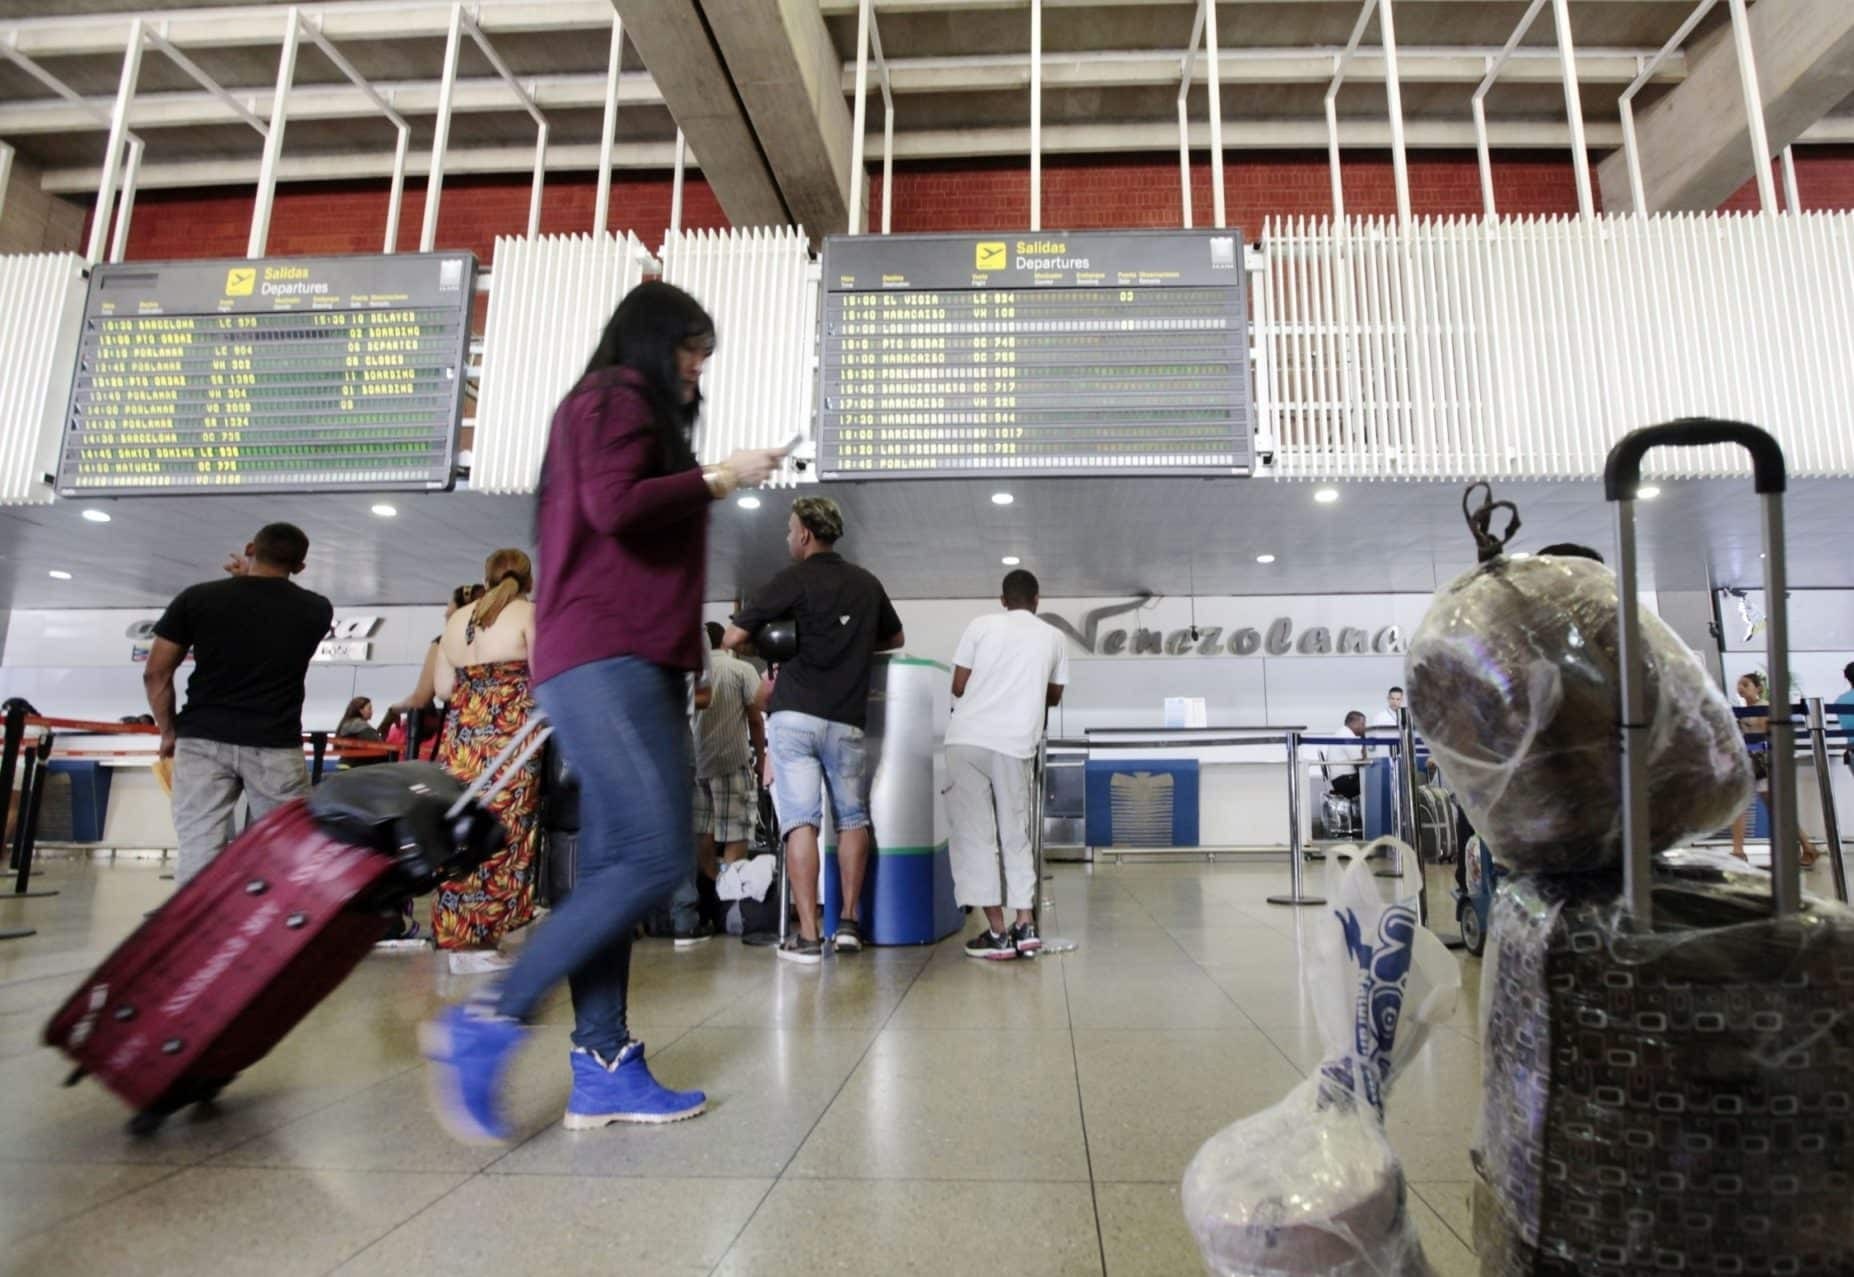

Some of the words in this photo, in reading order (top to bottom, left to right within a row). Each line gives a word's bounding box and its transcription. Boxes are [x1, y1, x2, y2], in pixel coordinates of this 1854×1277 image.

[1017, 241, 1066, 255] Salidas
[1016, 256, 1090, 271] Departures
[264, 267, 309, 280] Salidas
[261, 281, 328, 296] Departures
[883, 309, 944, 319] MARACAIBO
[139, 320, 195, 330] BARCELONA
[371, 312, 415, 322] DELAYED
[370, 326, 420, 337] BOARDING
[134, 348, 183, 358] PORLAMAR
[368, 340, 418, 351] DEPARTED
[132, 361, 181, 371] PORLAMAR
[365, 355, 403, 365] CLOSED
[883, 353, 944, 363] MARACAIBO
[364, 369, 415, 380] BOARDING
[882, 368, 937, 379] PORLAMAR
[128, 390, 177, 400] PORLAMAR
[362, 383, 413, 395] BOARDING
[882, 398, 944, 408] MARACAIBO
[125, 405, 175, 415] PORLAMAR
[123, 419, 172, 429] PORLAMAR
[881, 413, 944, 424] MARACAIBO
[121, 433, 177, 443] BARCELONA
[881, 429, 944, 439] BARCELONA
[880, 458, 936, 469] PORLAMAR
[1036, 592, 1408, 655] Venezolana
